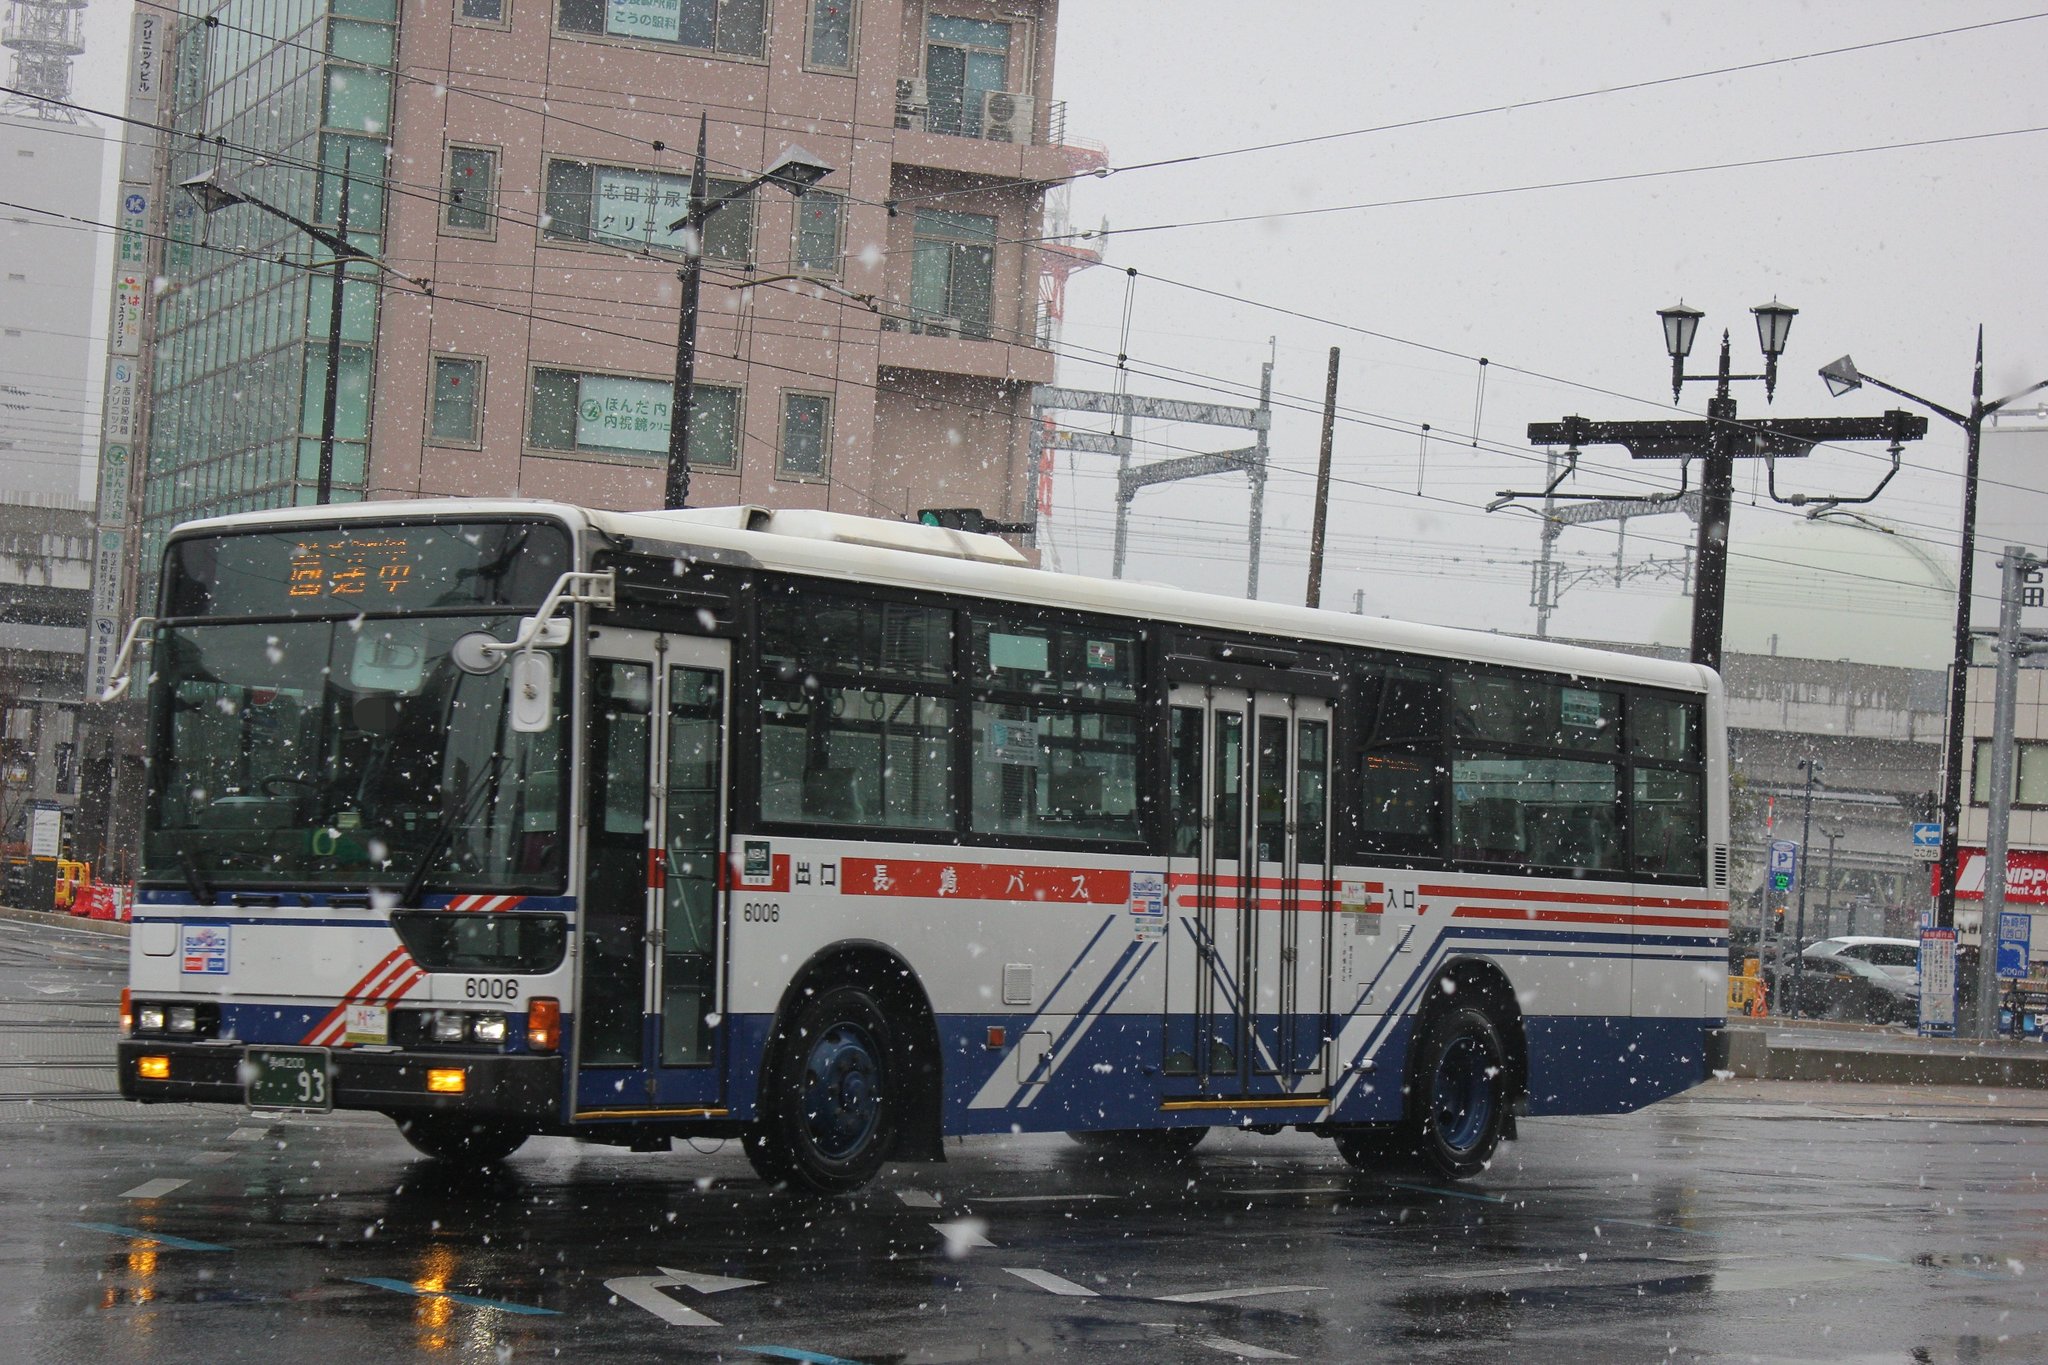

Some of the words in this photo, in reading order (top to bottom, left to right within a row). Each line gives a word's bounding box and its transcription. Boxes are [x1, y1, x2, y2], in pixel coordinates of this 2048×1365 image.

[139, 19, 153, 92] クリニックビル
[603, 183, 692, 209] 志田泌尿
[110, 386, 121, 434] クリニック
[1777, 852, 1788, 866] P
[1913, 848, 1939, 858] ここから
[796, 861, 836, 886] 出口
[2005, 868, 2048, 885] NIPP
[1387, 888, 1415, 909] 入口
[2004, 885, 2048, 896] Rent-A-
[744, 902, 780, 923] 6006
[2001, 967, 2025, 977] 200m
[466, 977, 518, 999] 6006
